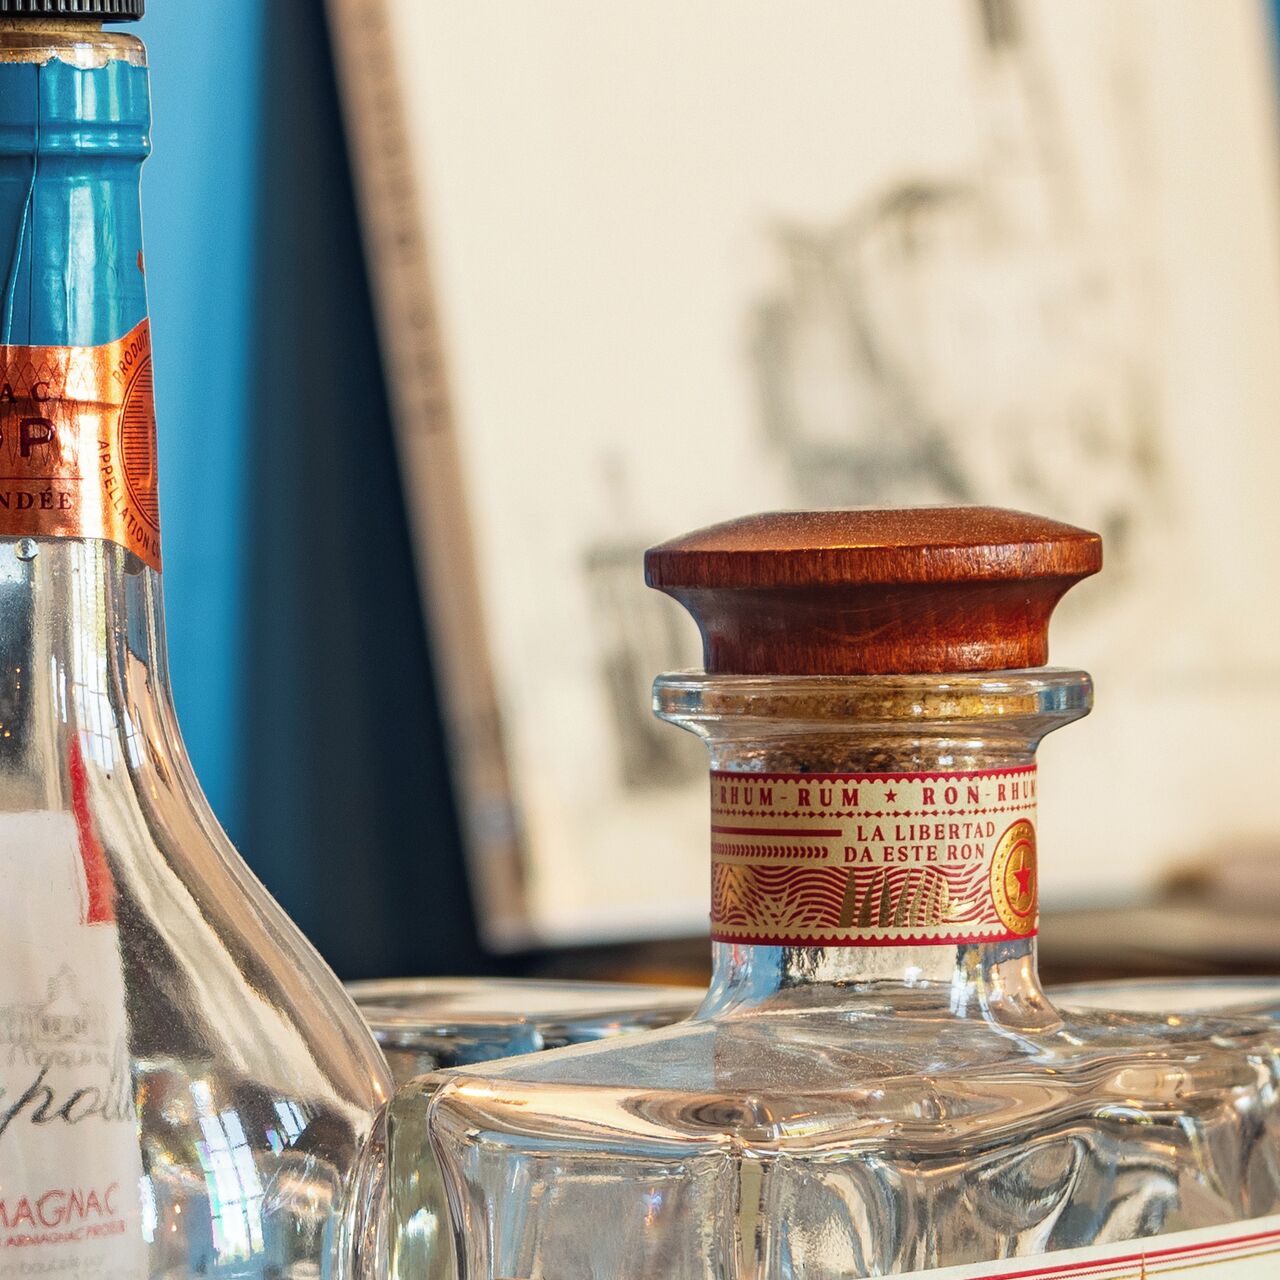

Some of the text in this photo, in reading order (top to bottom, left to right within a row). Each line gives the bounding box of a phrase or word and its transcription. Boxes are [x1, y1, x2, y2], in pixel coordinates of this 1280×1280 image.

[97, 439, 152, 553] APPELLATION
[856, 820, 996, 842] LA LIBERTAD
[843, 842, 986, 863] DA ESTE RON
